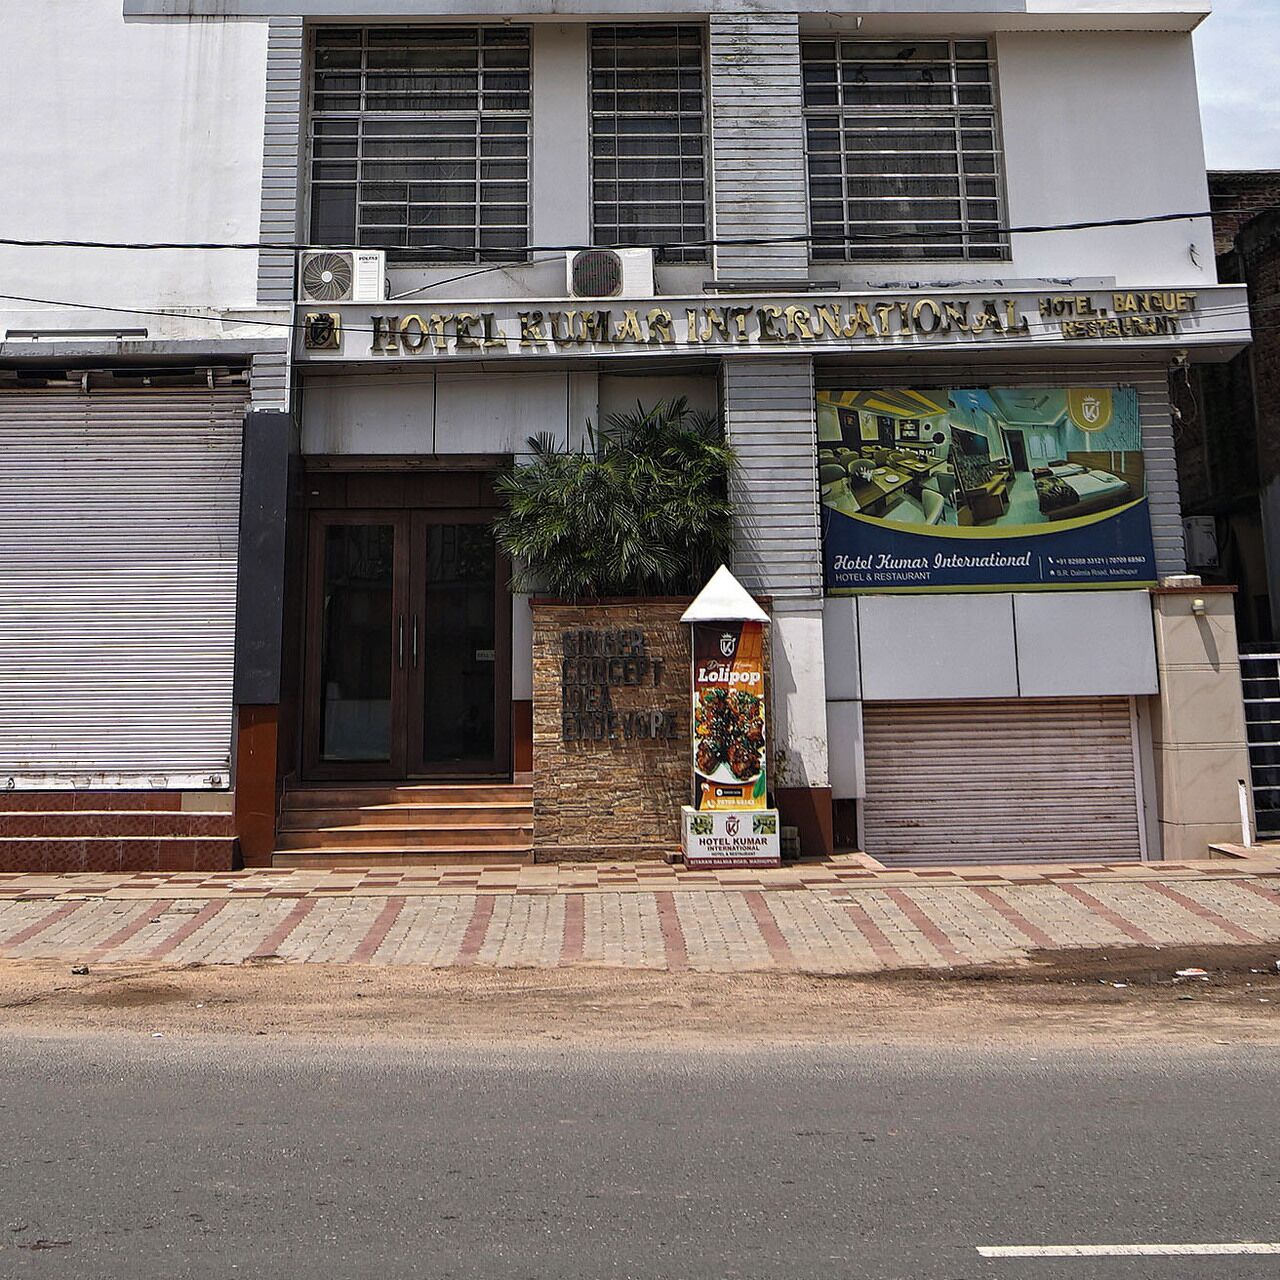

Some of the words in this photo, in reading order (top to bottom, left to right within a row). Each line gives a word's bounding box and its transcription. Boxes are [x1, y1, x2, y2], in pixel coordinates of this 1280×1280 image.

[1113, 291, 1198, 314] BANQUET
[370, 311, 507, 351] HOTEL
[518, 308, 673, 348] KUMAR
[685, 298, 1030, 345] INTERNATIONAL
[1062, 314, 1181, 338] RESTAURANT
[834, 554, 872, 570] Hotel
[875, 553, 929, 569] Kumar
[932, 551, 1031, 569] International
[835, 573, 866, 581] HOTEL
[874, 572, 931, 581] RESTAURANT
[562, 657, 664, 686] CONCEPT
[698, 667, 760, 686] Lolipop
[699, 838, 730, 846] HOTEL
[733, 837, 768, 846] KUMAR
